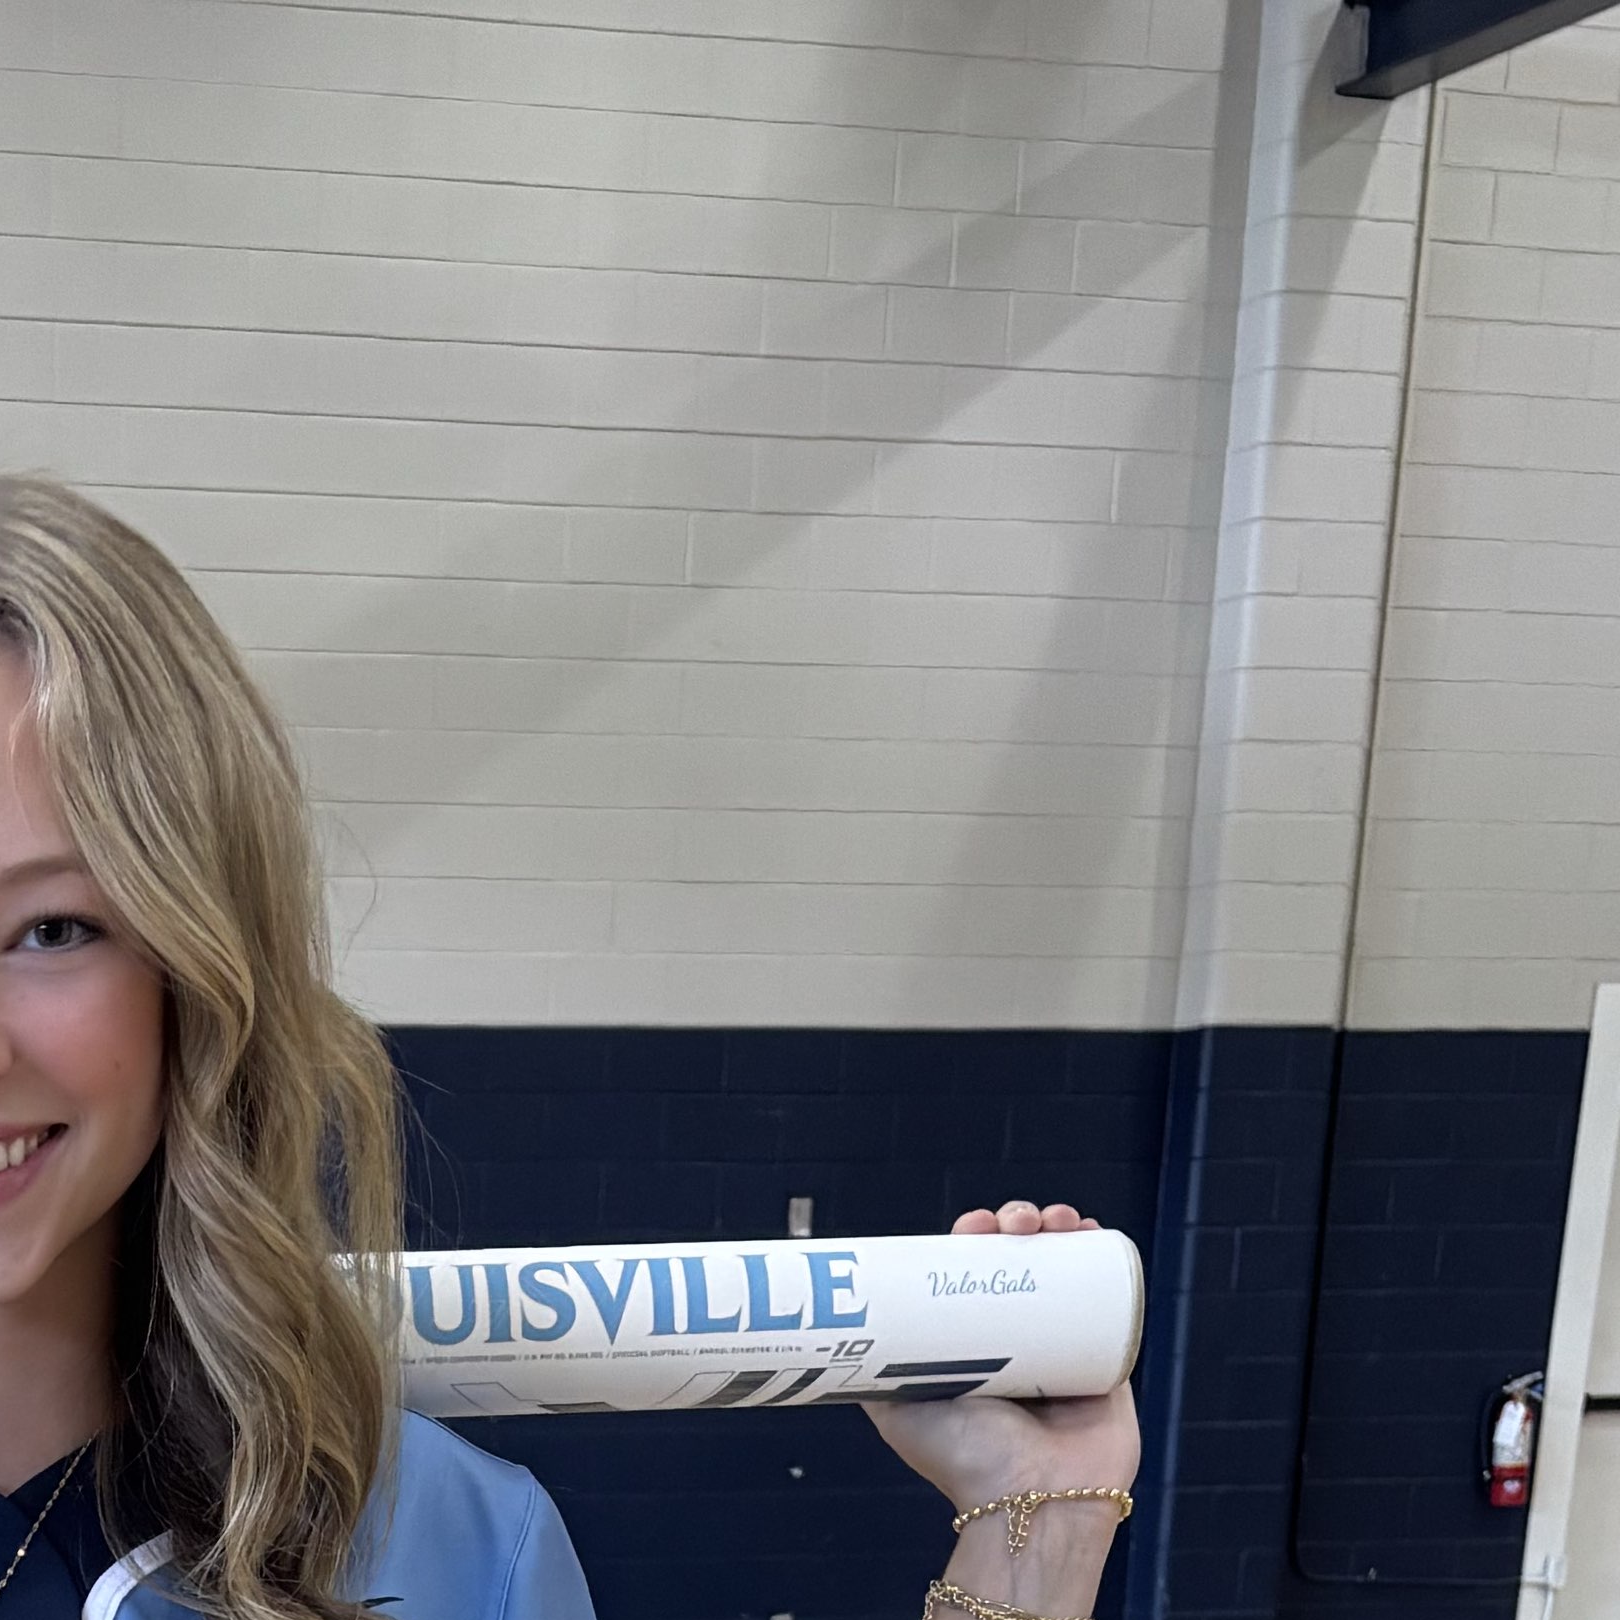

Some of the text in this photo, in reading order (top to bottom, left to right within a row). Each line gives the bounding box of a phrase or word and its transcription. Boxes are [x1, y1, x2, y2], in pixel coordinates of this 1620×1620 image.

[927, 1268, 1037, 1297] ValorGals
[402, 1251, 868, 1345] UISVILLE
[815, 1338, 875, 1358] -10
